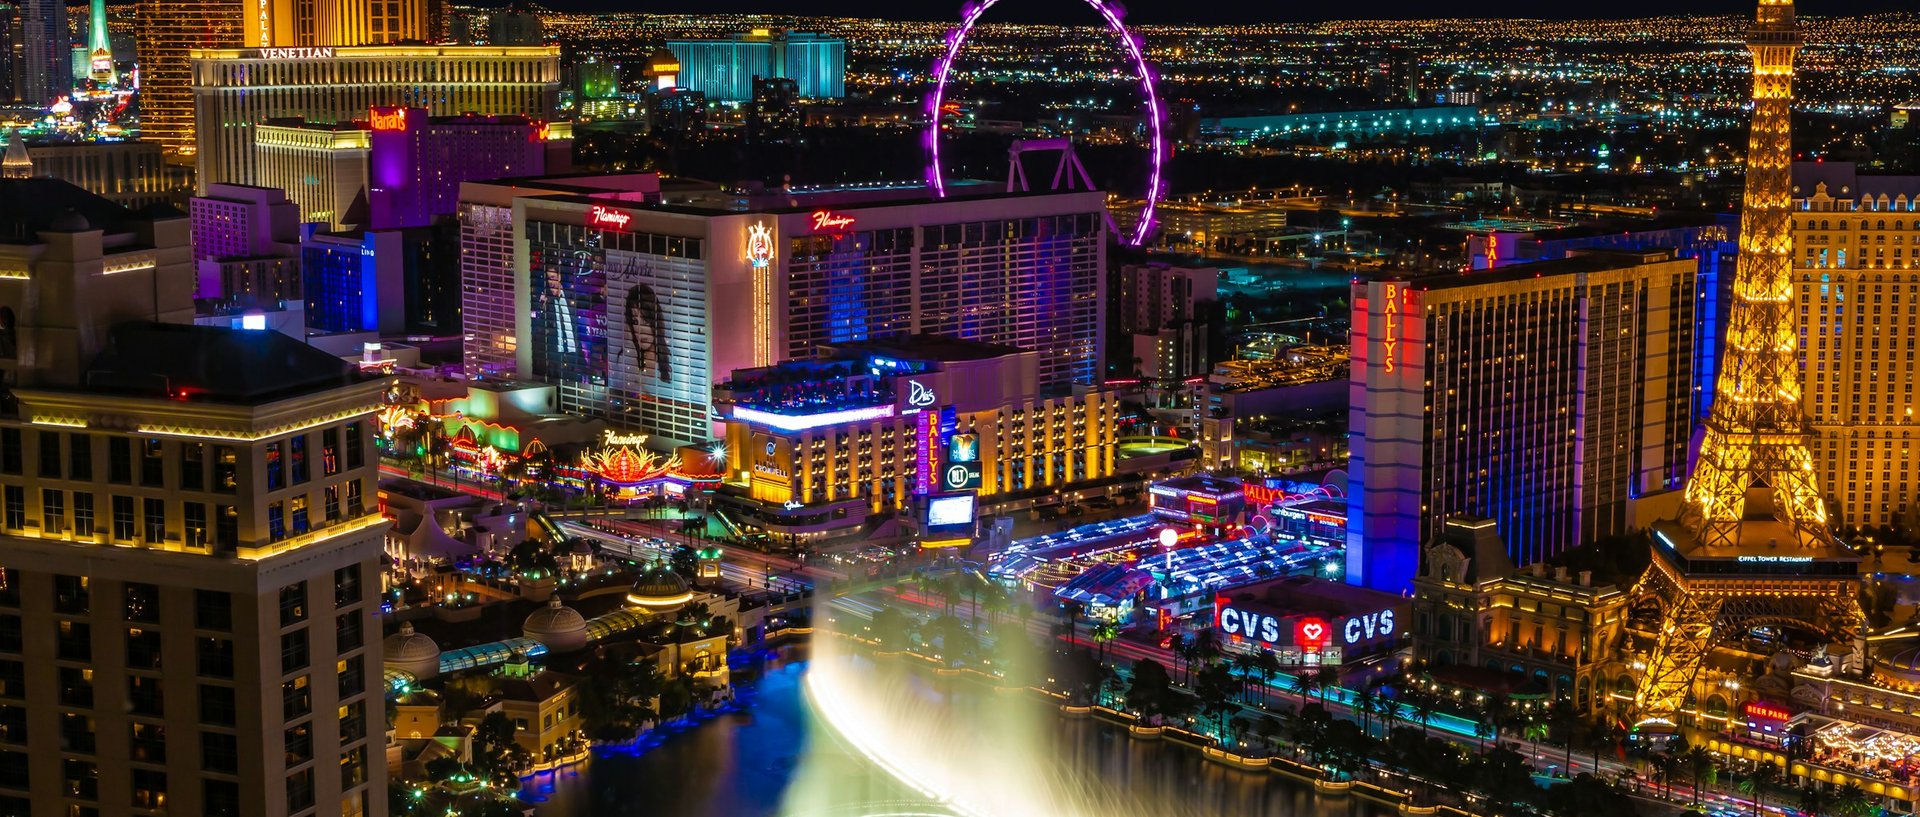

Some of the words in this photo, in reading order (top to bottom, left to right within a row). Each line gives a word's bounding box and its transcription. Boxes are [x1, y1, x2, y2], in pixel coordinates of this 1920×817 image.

[260, 47, 332, 59] VENETIAN
[593, 206, 630, 228] Flamingo
[812, 211, 855, 230] Flamingo
[604, 429, 648, 449] Flamingo
[951, 469, 964, 483] BLT
[1243, 483, 1284, 502] BALLY'S
[1221, 608, 1279, 643] CVS
[1344, 609, 1394, 644] CVS
[1747, 705, 1767, 716] BEER
[1768, 709, 1788, 721] PARK
